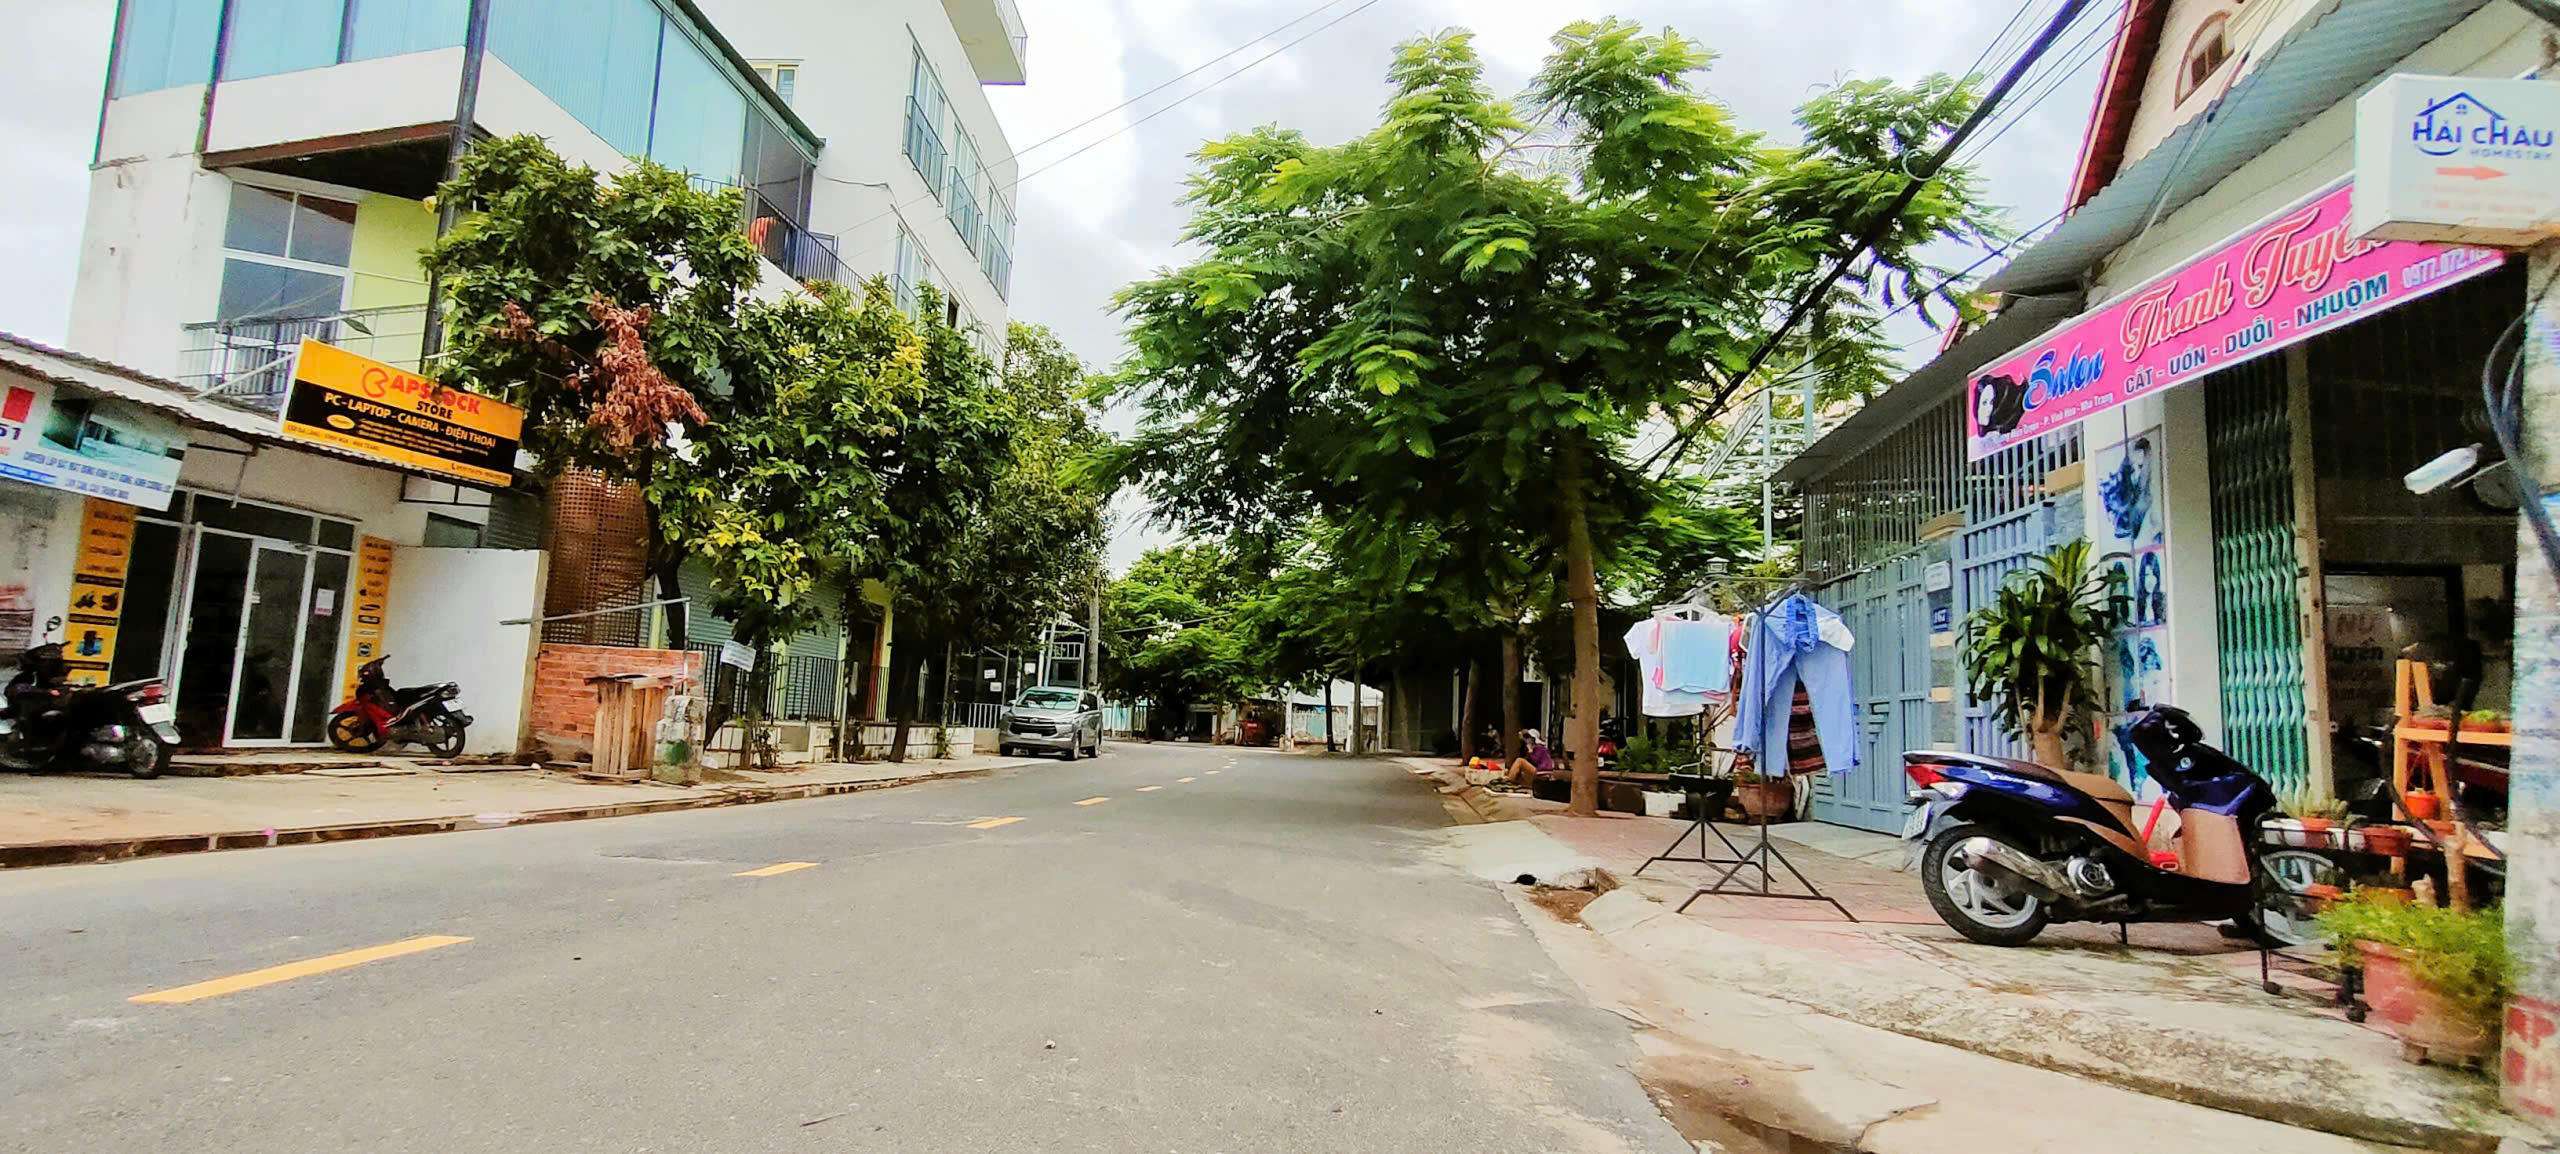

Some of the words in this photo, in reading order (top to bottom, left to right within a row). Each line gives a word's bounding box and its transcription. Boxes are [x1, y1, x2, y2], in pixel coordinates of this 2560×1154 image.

[2471, 117, 2554, 148] CHÂU
[2120, 280, 2235, 362] Thanh
[2125, 363, 2152, 394] CẮT
[2169, 344, 2206, 376] UỐN
[2295, 271, 2389, 330] NHUỘM
[2022, 342, 2105, 412] Salon
[324, 391, 342, 408] PC
[348, 399, 392, 419] LAPTOP
[397, 411, 440, 433] CAMERA
[445, 426, 469, 442] ĐIỆN
[469, 432, 497, 450] THOẠI
[416, 400, 454, 420] STORE
